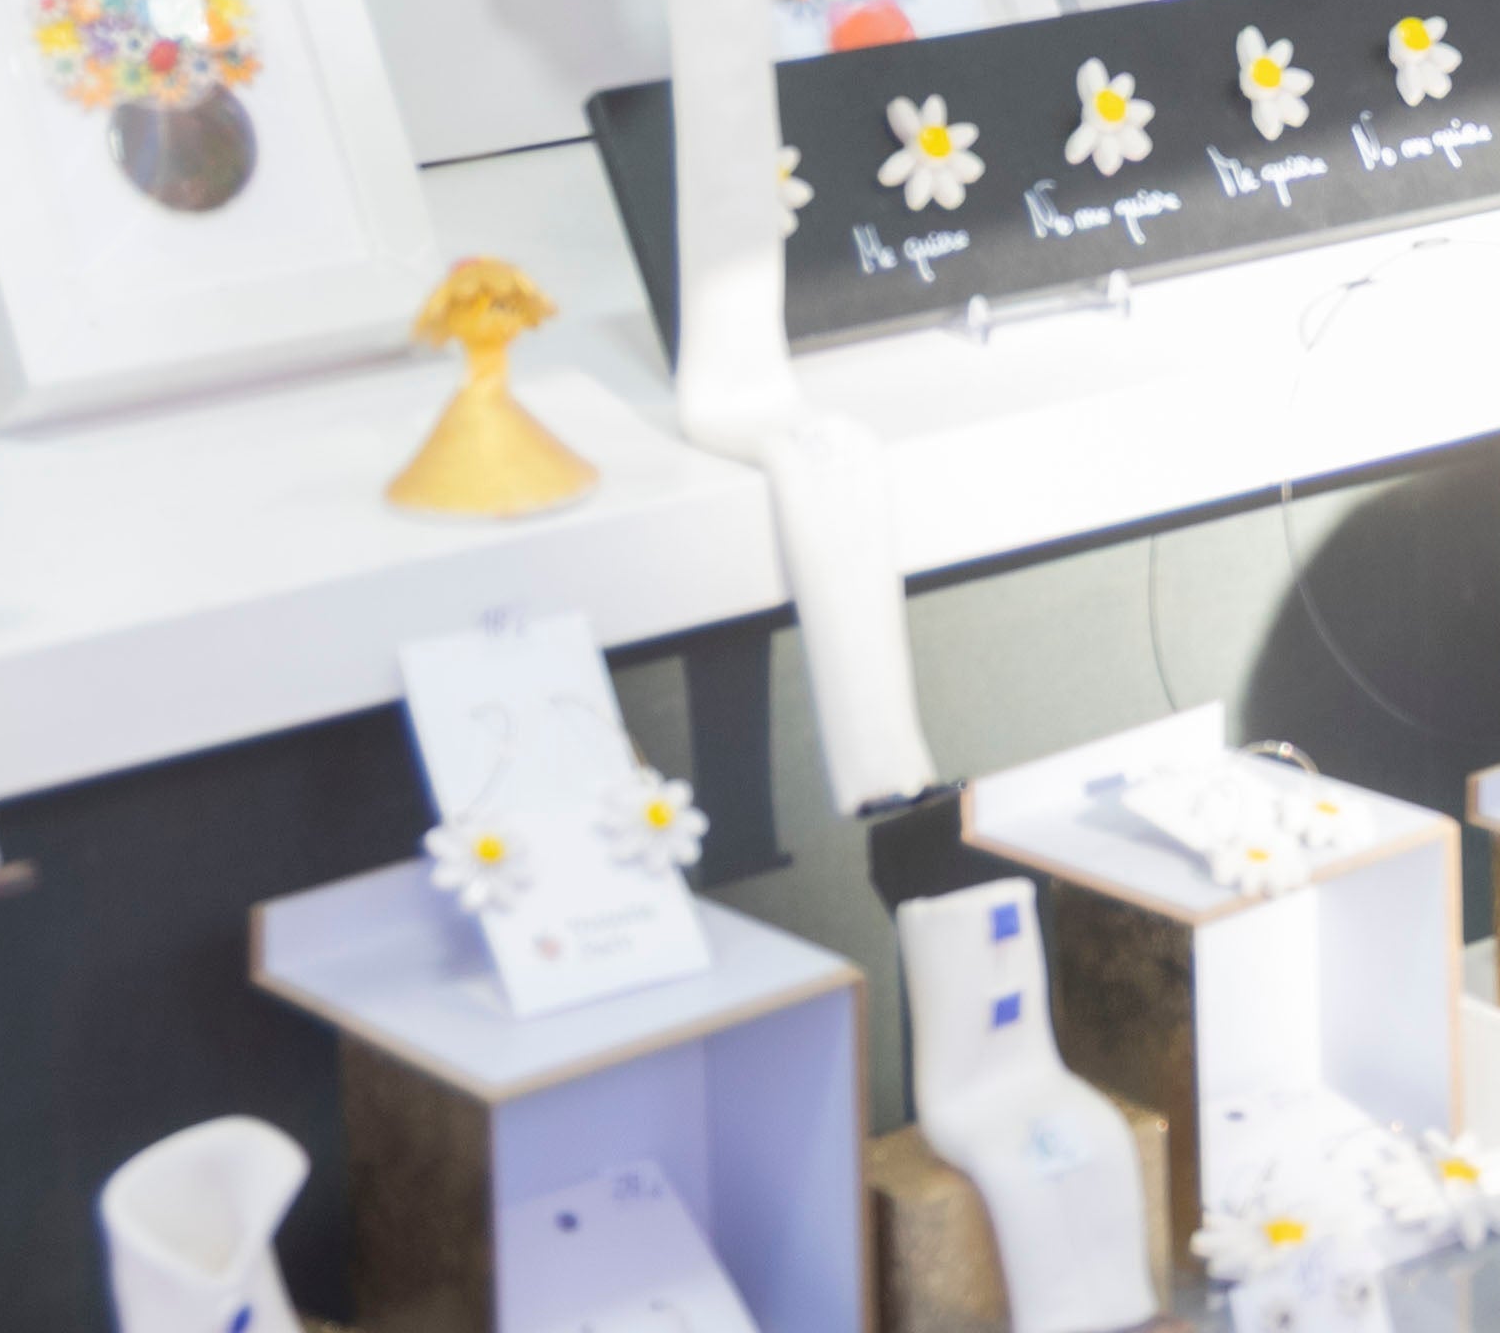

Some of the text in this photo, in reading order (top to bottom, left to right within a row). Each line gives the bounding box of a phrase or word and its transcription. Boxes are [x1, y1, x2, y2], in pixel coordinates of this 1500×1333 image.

[852, 223, 898, 273] Me
[904, 230, 971, 283] quiere
[1024, 179, 1075, 238] No
[1113, 188, 1183, 245] quiere
